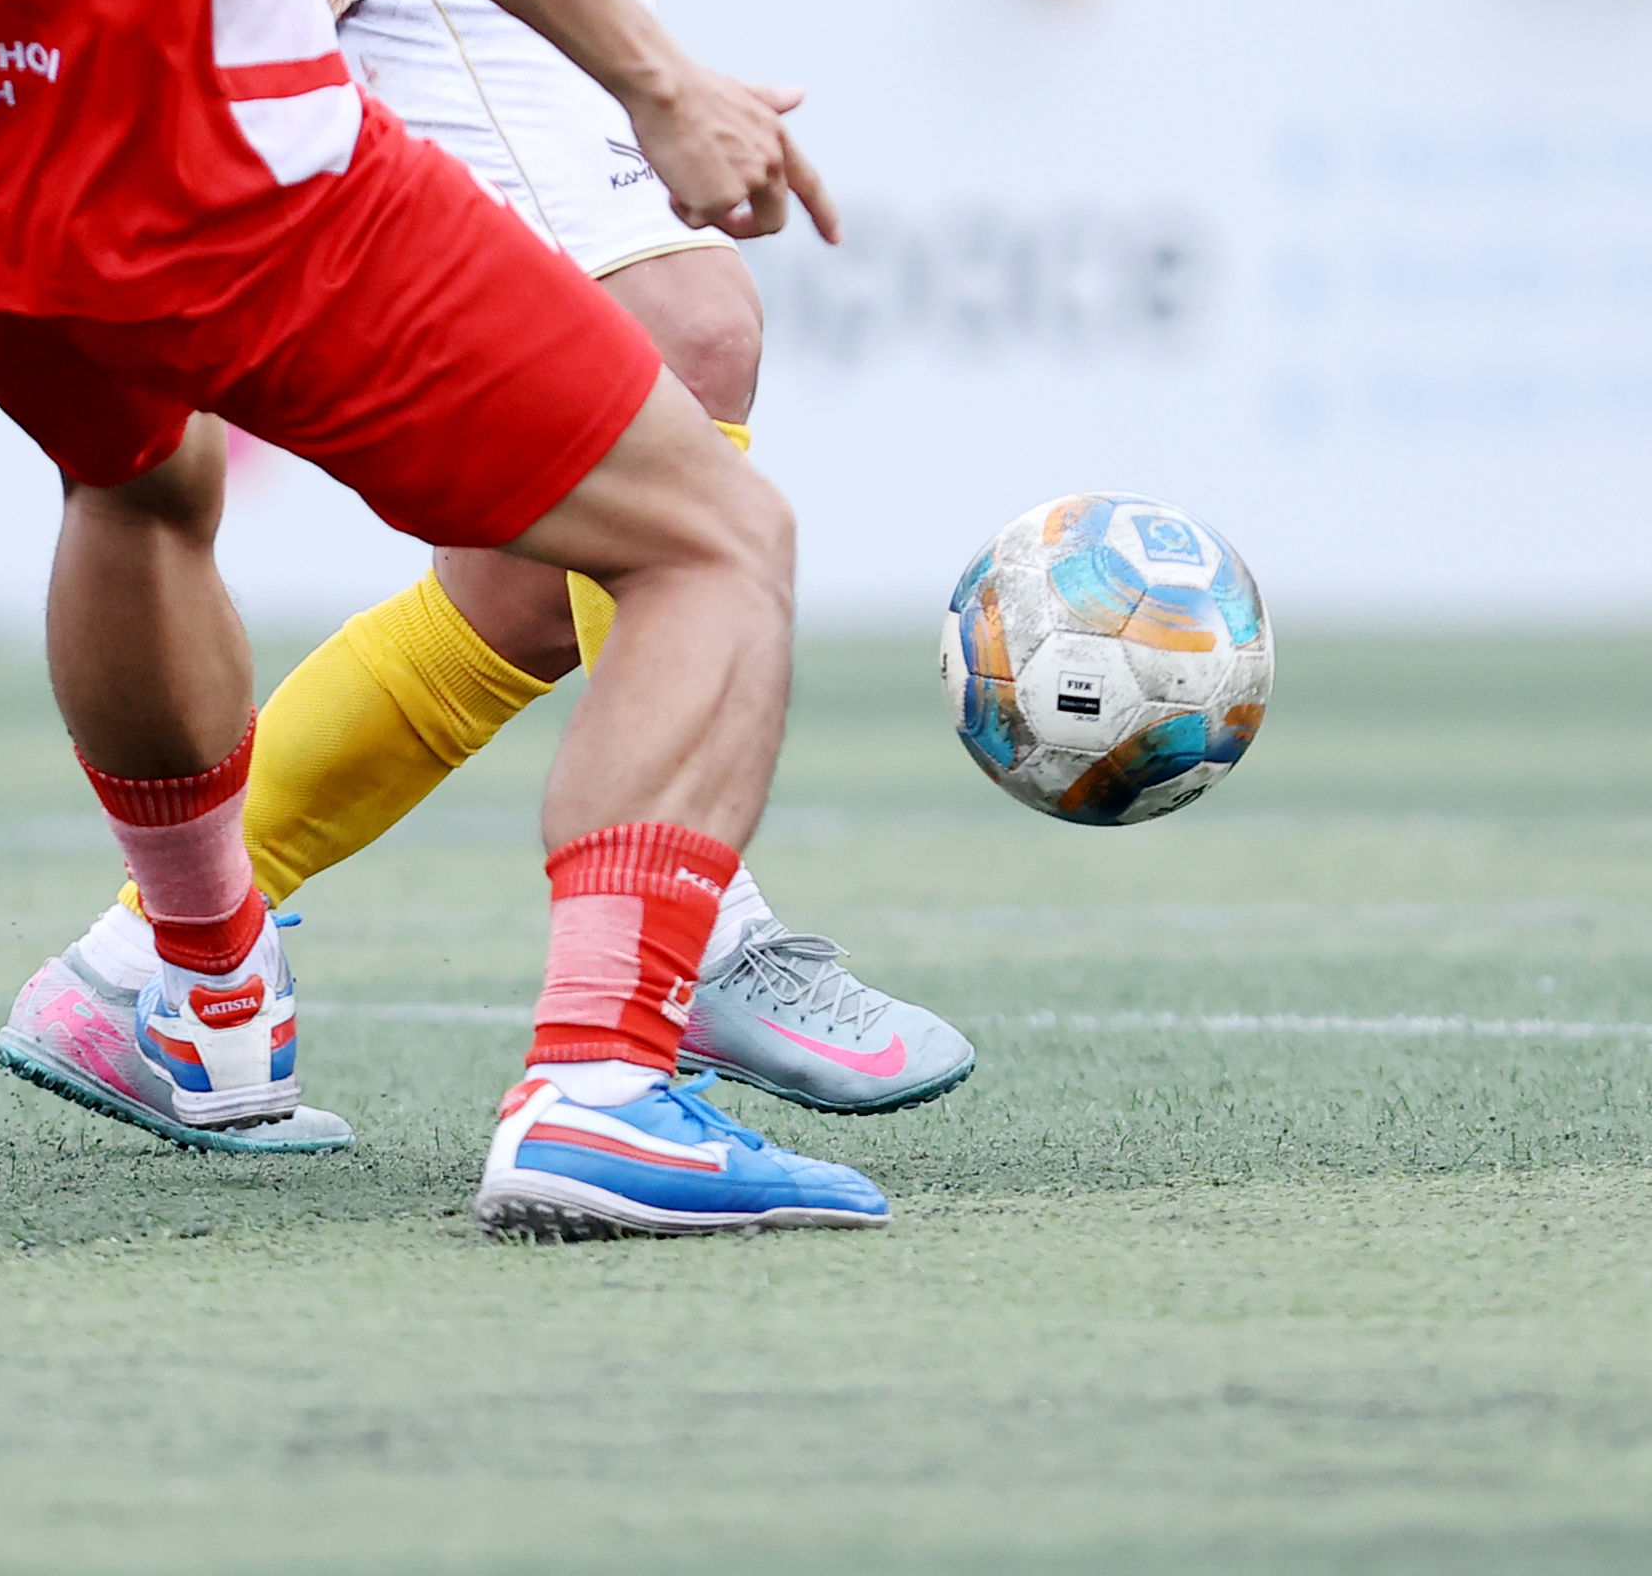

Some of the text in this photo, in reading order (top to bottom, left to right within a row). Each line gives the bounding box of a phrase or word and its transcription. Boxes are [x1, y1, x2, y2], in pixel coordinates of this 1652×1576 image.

[609, 165, 654, 190] KAMI
[1067, 680, 1093, 691] FIFA
[201, 996, 259, 1016] ARTISTA
